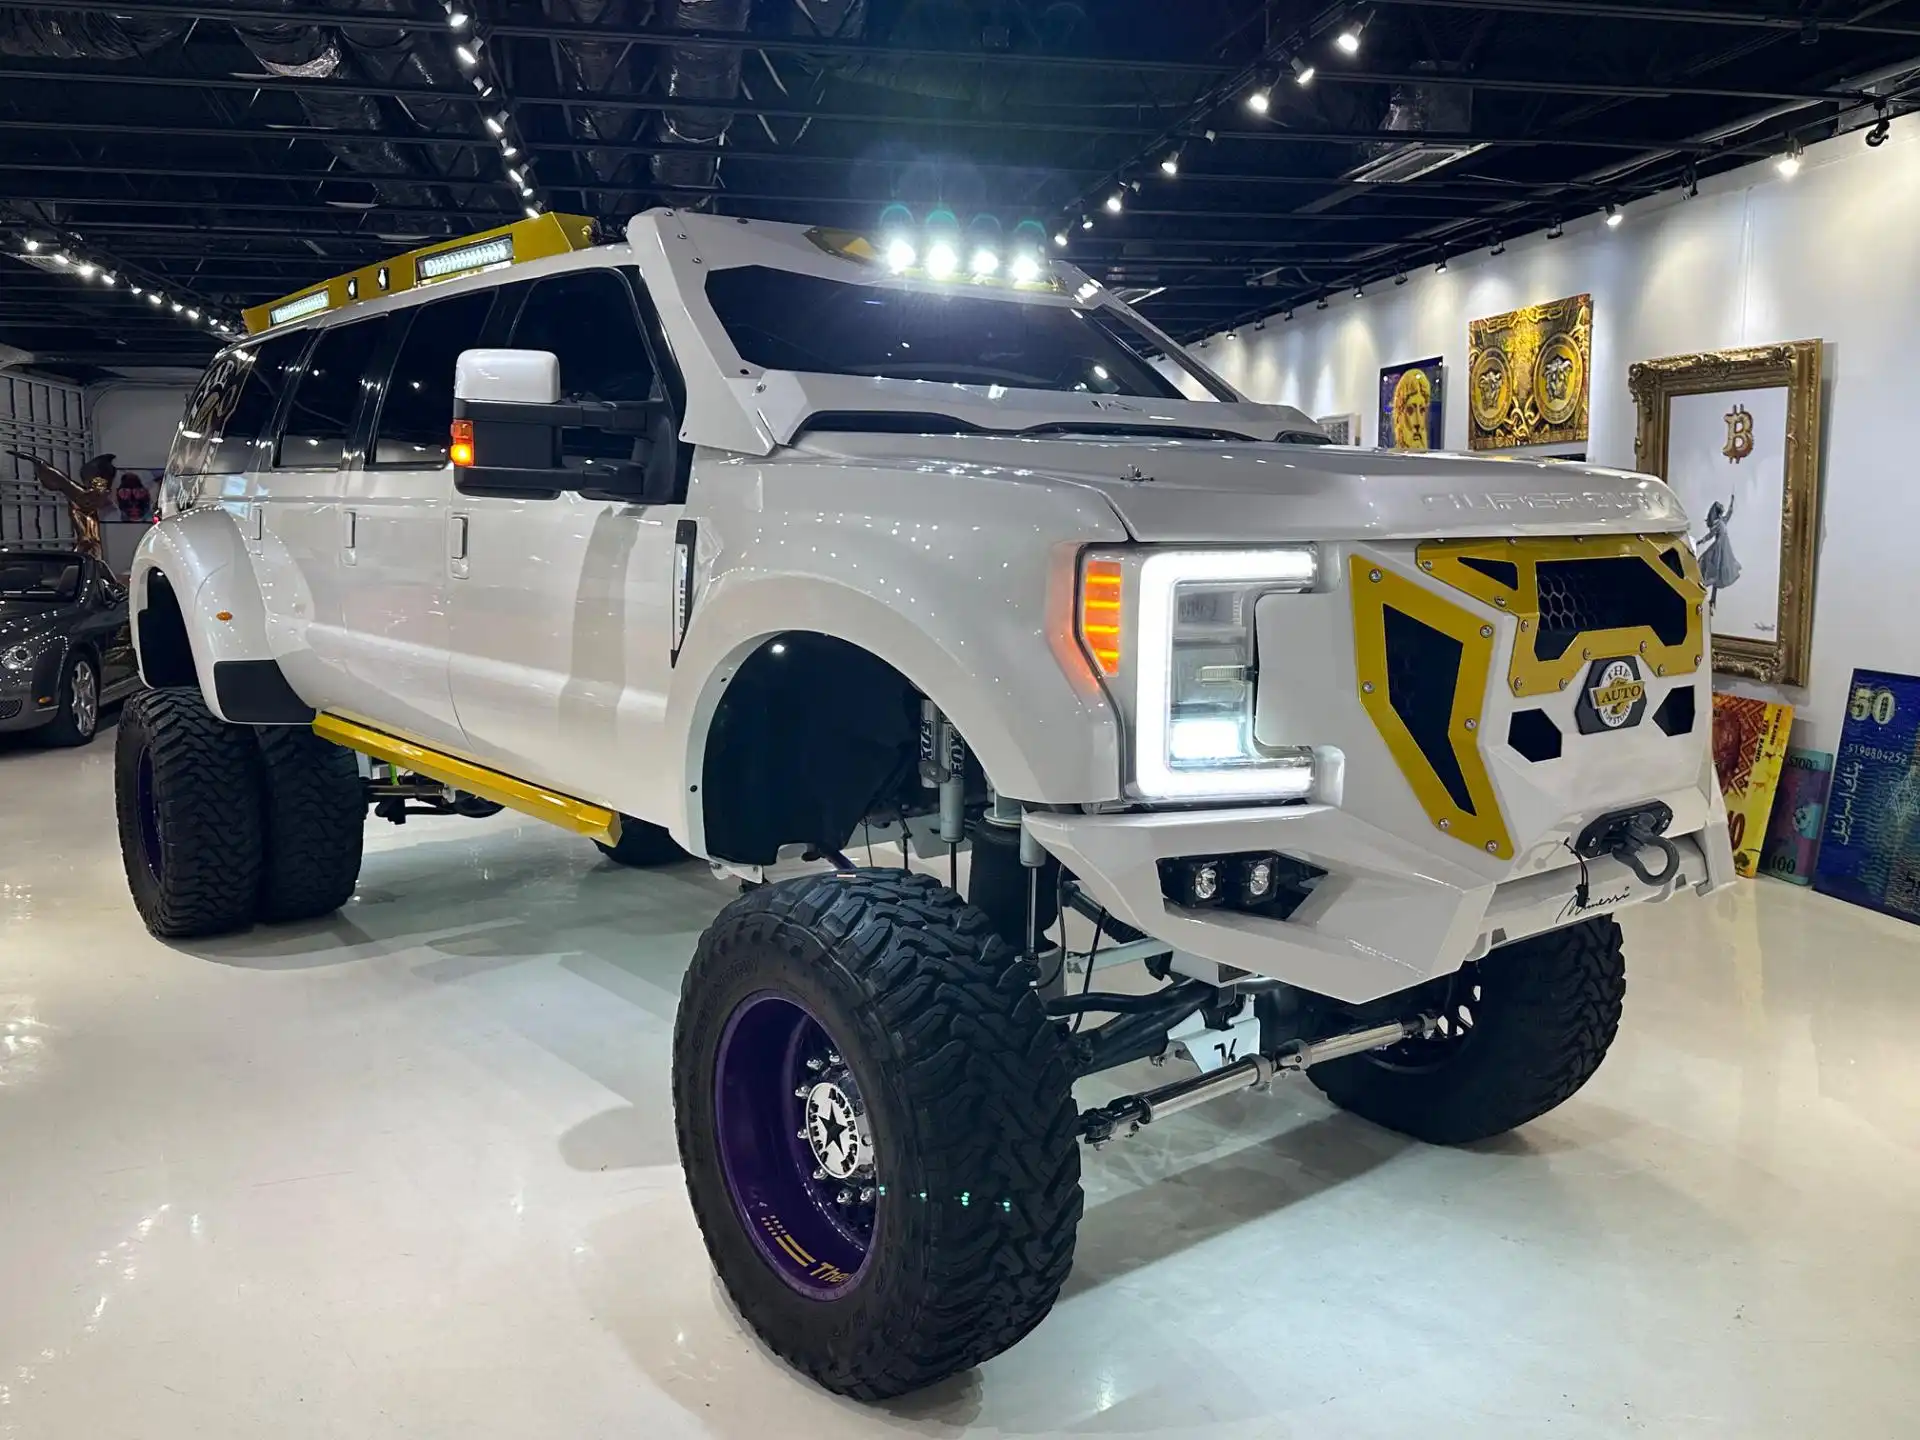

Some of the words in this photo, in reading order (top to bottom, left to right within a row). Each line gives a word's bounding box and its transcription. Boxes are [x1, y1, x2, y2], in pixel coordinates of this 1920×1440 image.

[1607, 665, 1631, 680] THE
[1601, 685, 1642, 704] AUTO
[1850, 687, 1896, 725] 50
[1755, 737, 1766, 764] RAND
[1771, 855, 1796, 875] 100
